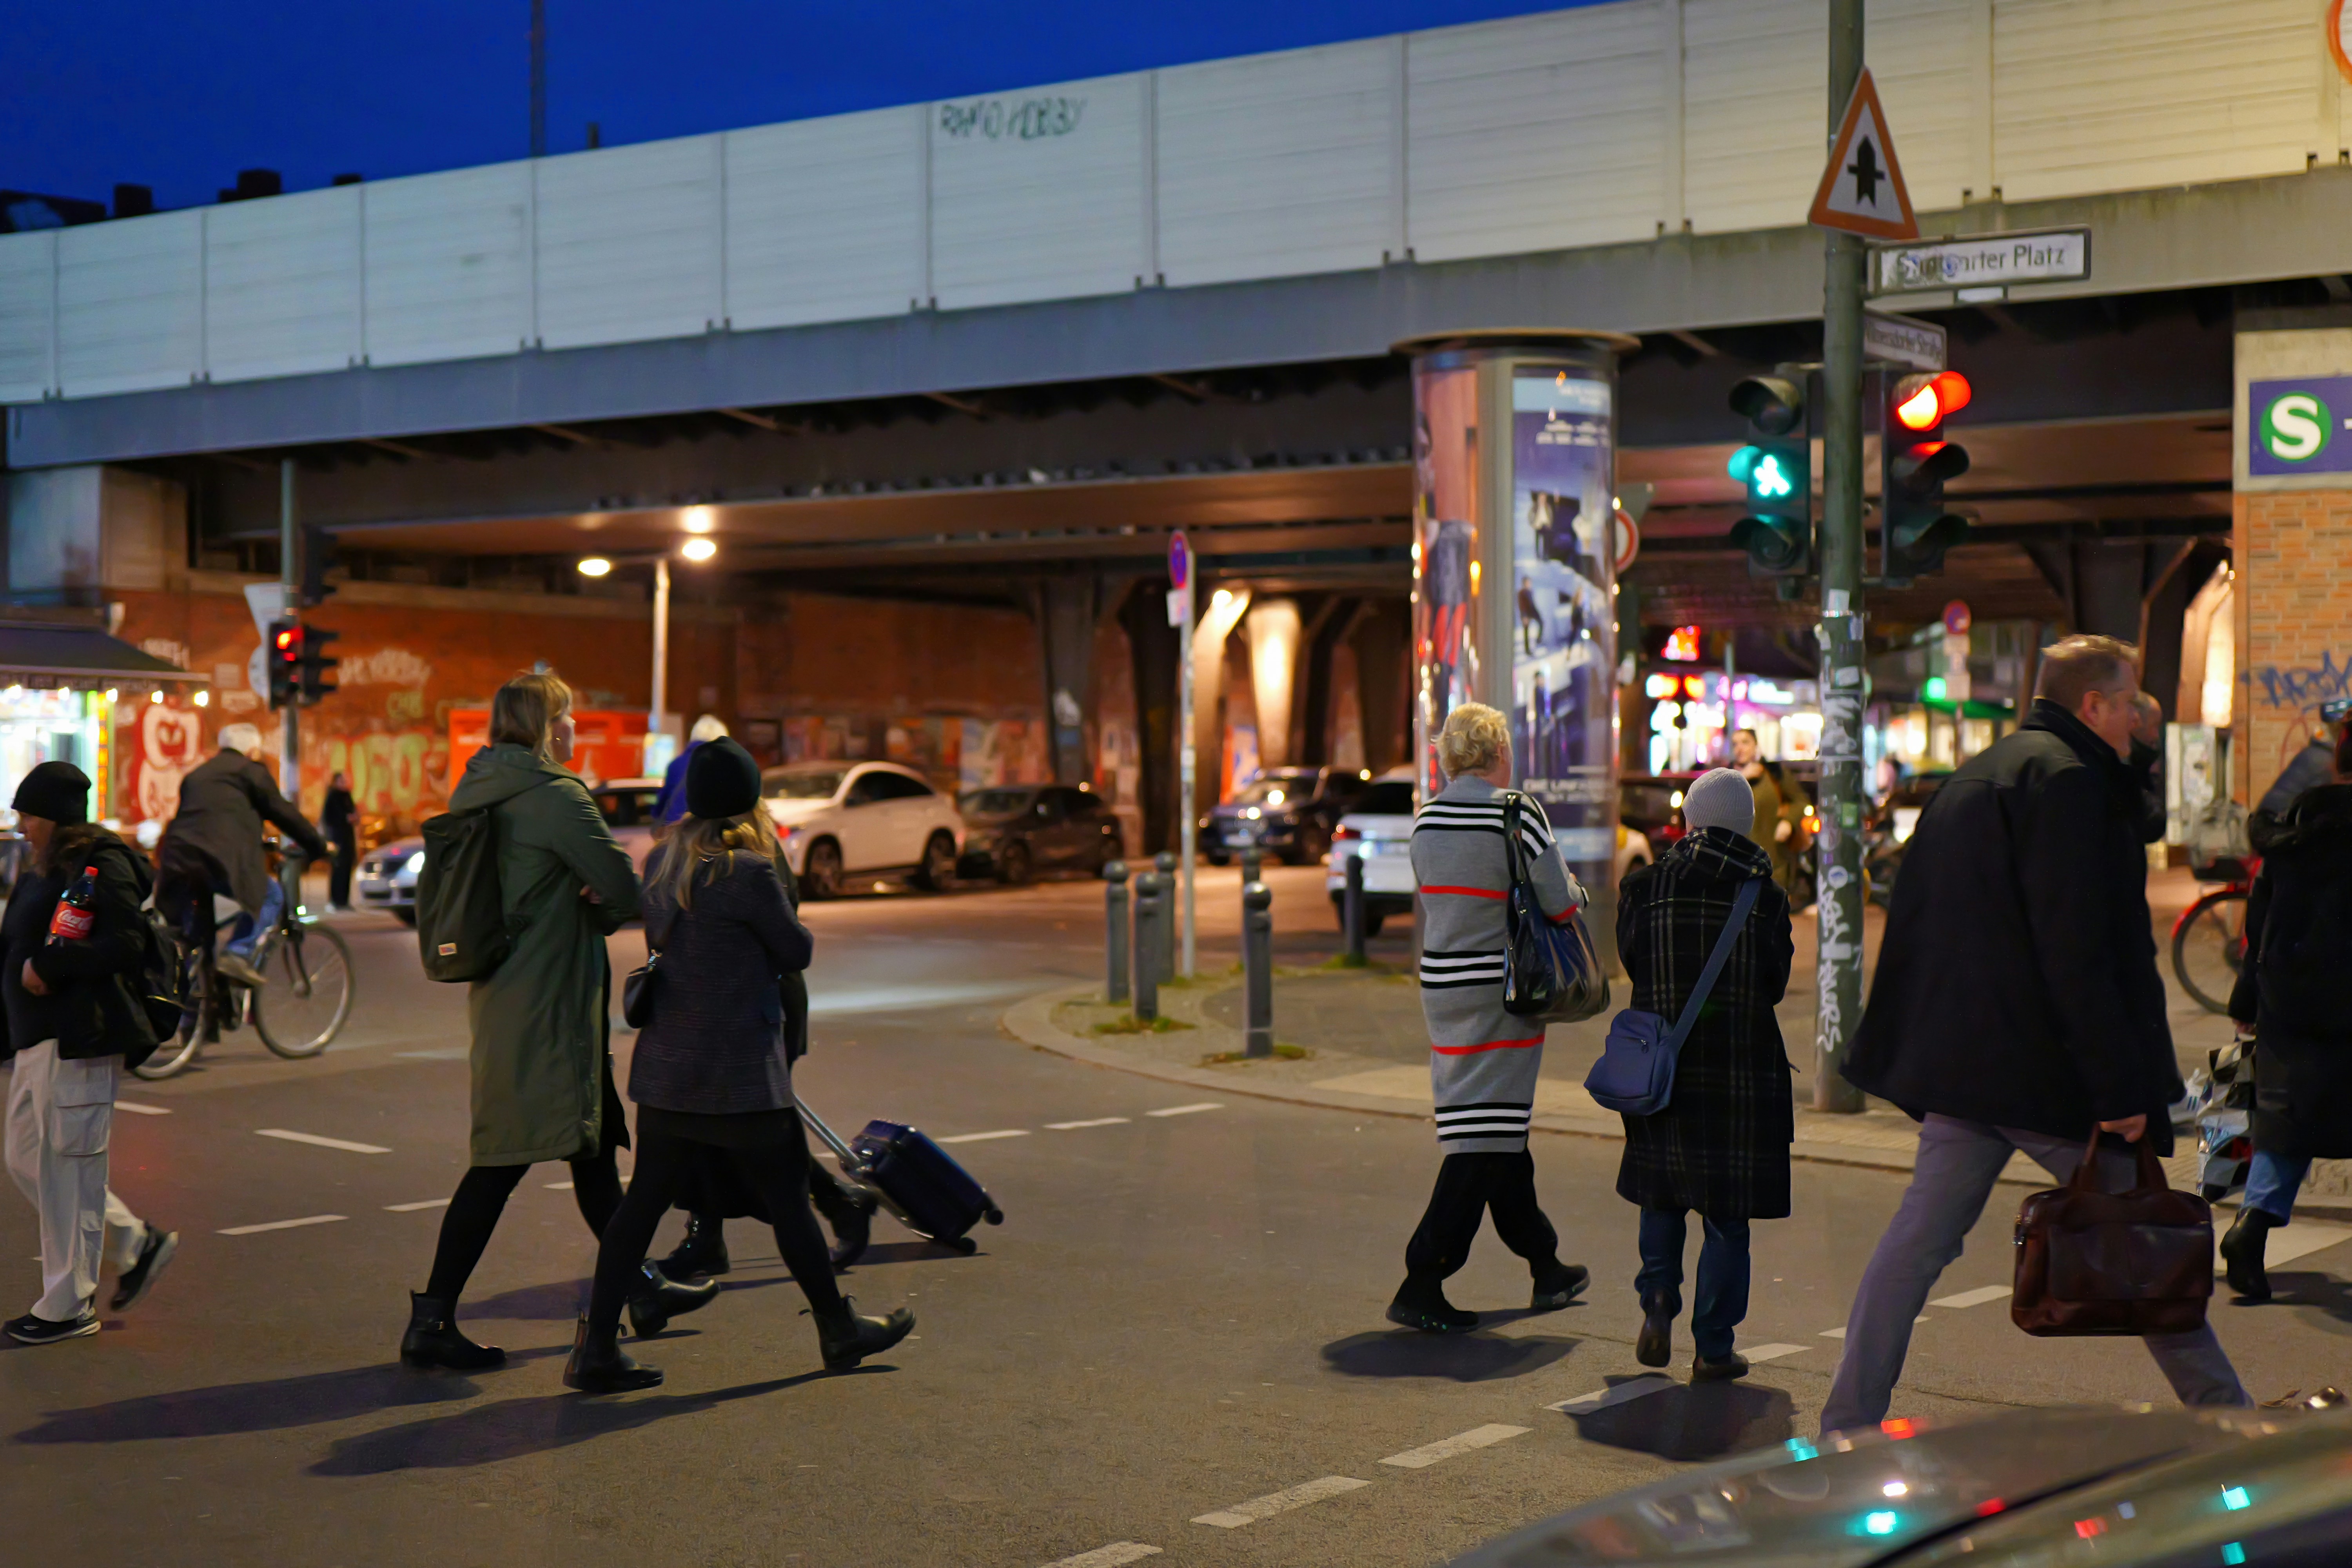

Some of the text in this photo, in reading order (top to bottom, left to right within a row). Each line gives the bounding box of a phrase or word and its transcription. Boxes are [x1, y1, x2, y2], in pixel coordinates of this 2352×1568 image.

[1896, 244, 2065, 277] Sarter Platz
[2271, 396, 2321, 459] S
